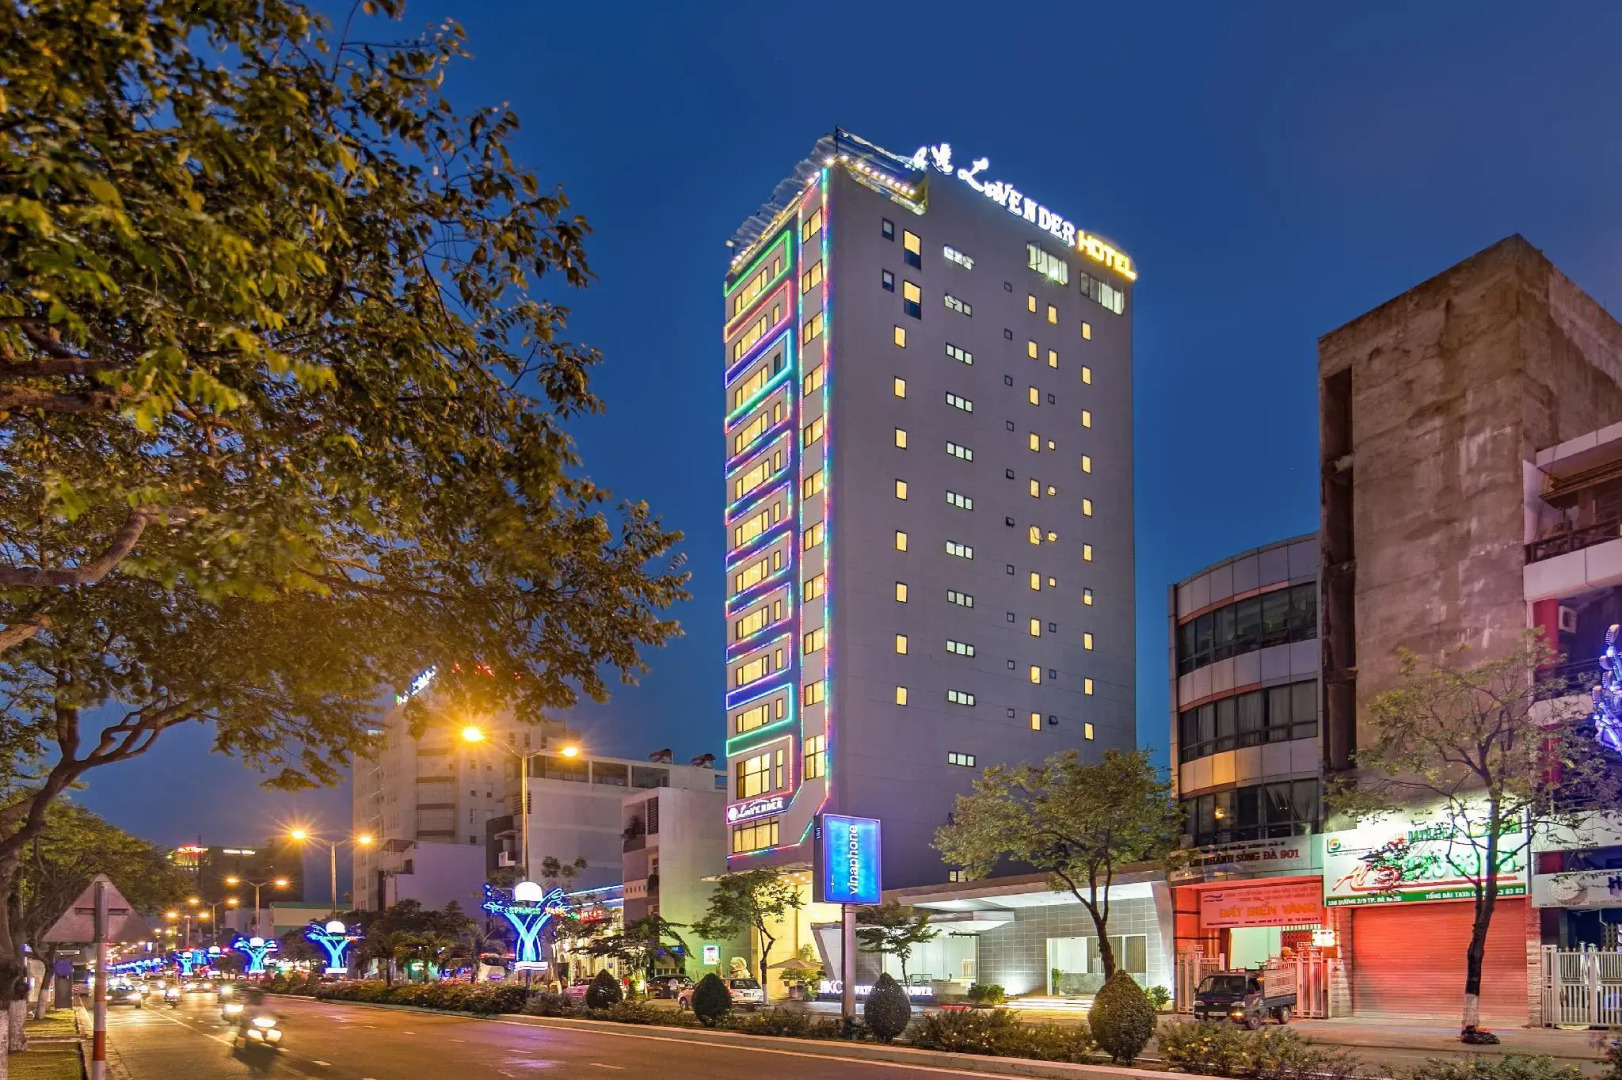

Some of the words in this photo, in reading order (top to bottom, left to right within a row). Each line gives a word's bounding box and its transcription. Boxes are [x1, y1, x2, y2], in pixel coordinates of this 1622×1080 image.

[1077, 230, 1138, 281] HOTEL
[847, 824, 859, 895] vinaphone
[1263, 848, 1278, 860] ĐÀ
[1280, 848, 1300, 860] 901
